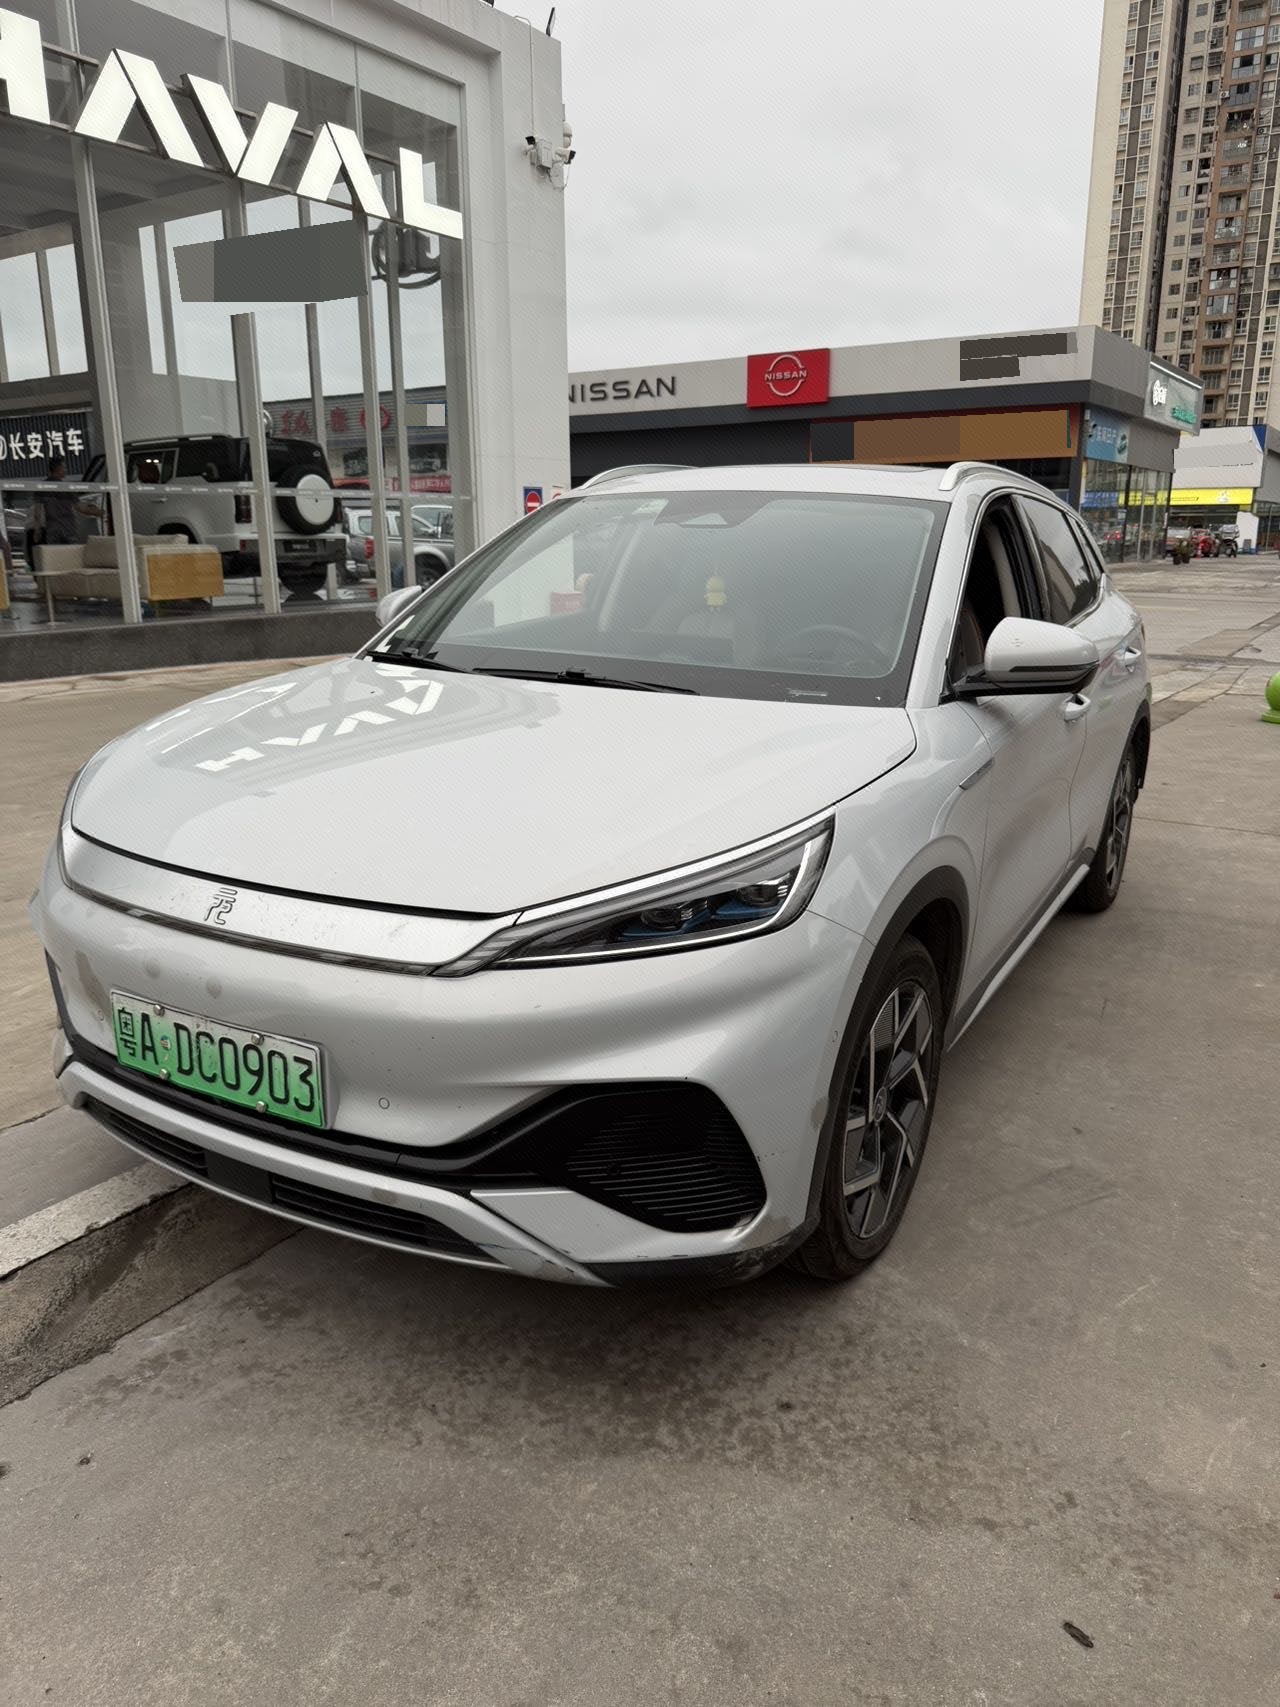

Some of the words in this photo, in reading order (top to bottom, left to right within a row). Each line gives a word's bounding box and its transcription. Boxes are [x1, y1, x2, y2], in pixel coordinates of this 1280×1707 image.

[765, 369, 807, 381] NISSAN
[9, 428, 84, 460] 长安汽车
